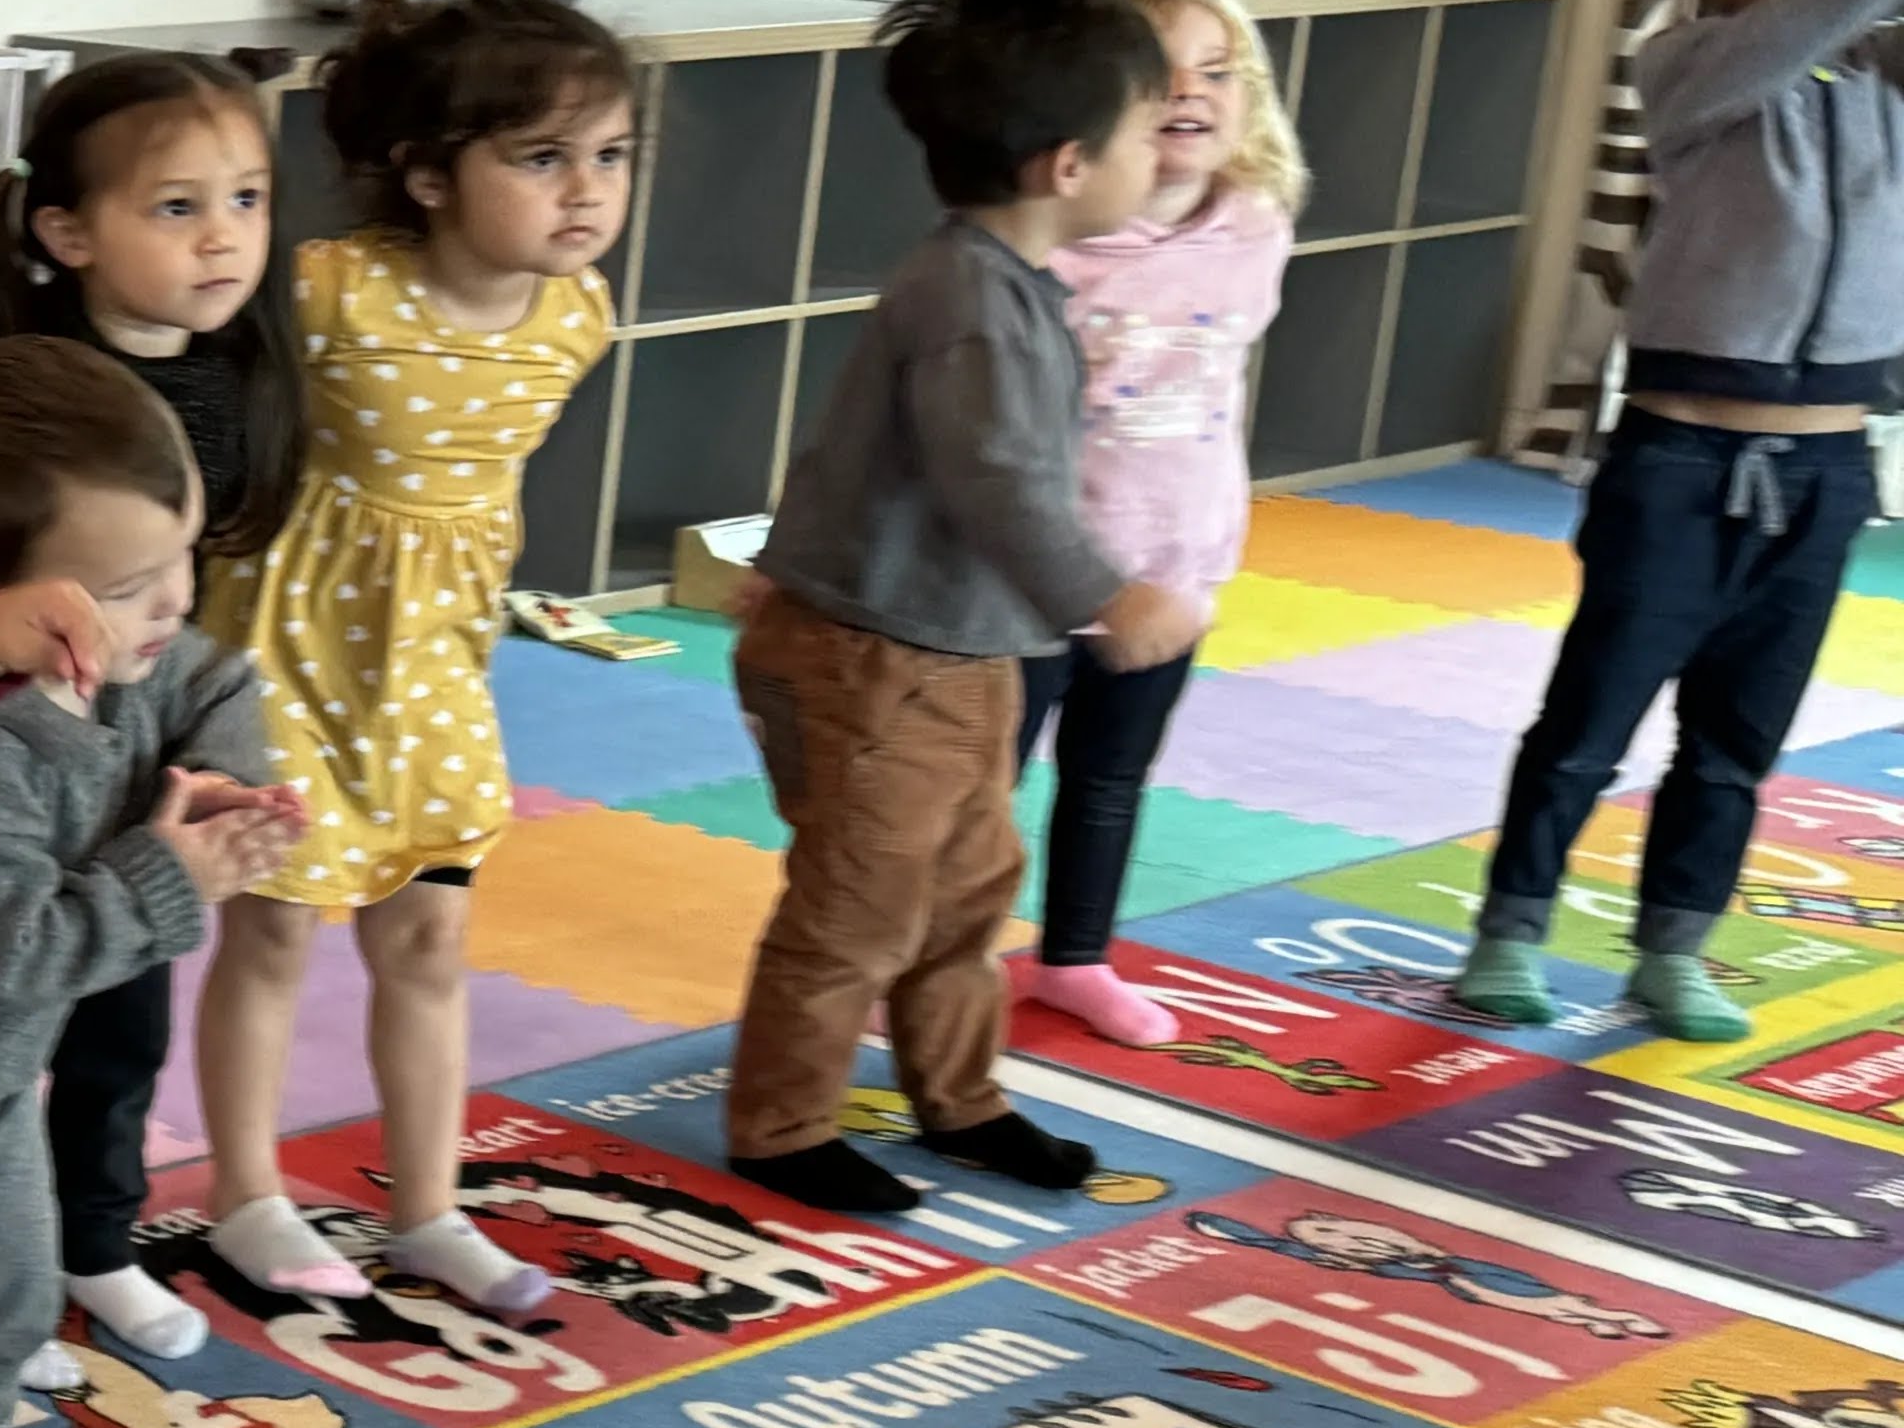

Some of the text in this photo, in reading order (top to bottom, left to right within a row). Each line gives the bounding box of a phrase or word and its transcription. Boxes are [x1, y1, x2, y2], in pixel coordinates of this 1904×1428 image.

[1129, 965, 1341, 1035] N
[1389, 1048, 1519, 1086] newt
[455, 1115, 568, 1159] eart
[1445, 1090, 1806, 1176] Mm
[1033, 1232, 1229, 1300] jacket
[265, 1311, 608, 1413] Gg
[1191, 1291, 1571, 1399] Jj
